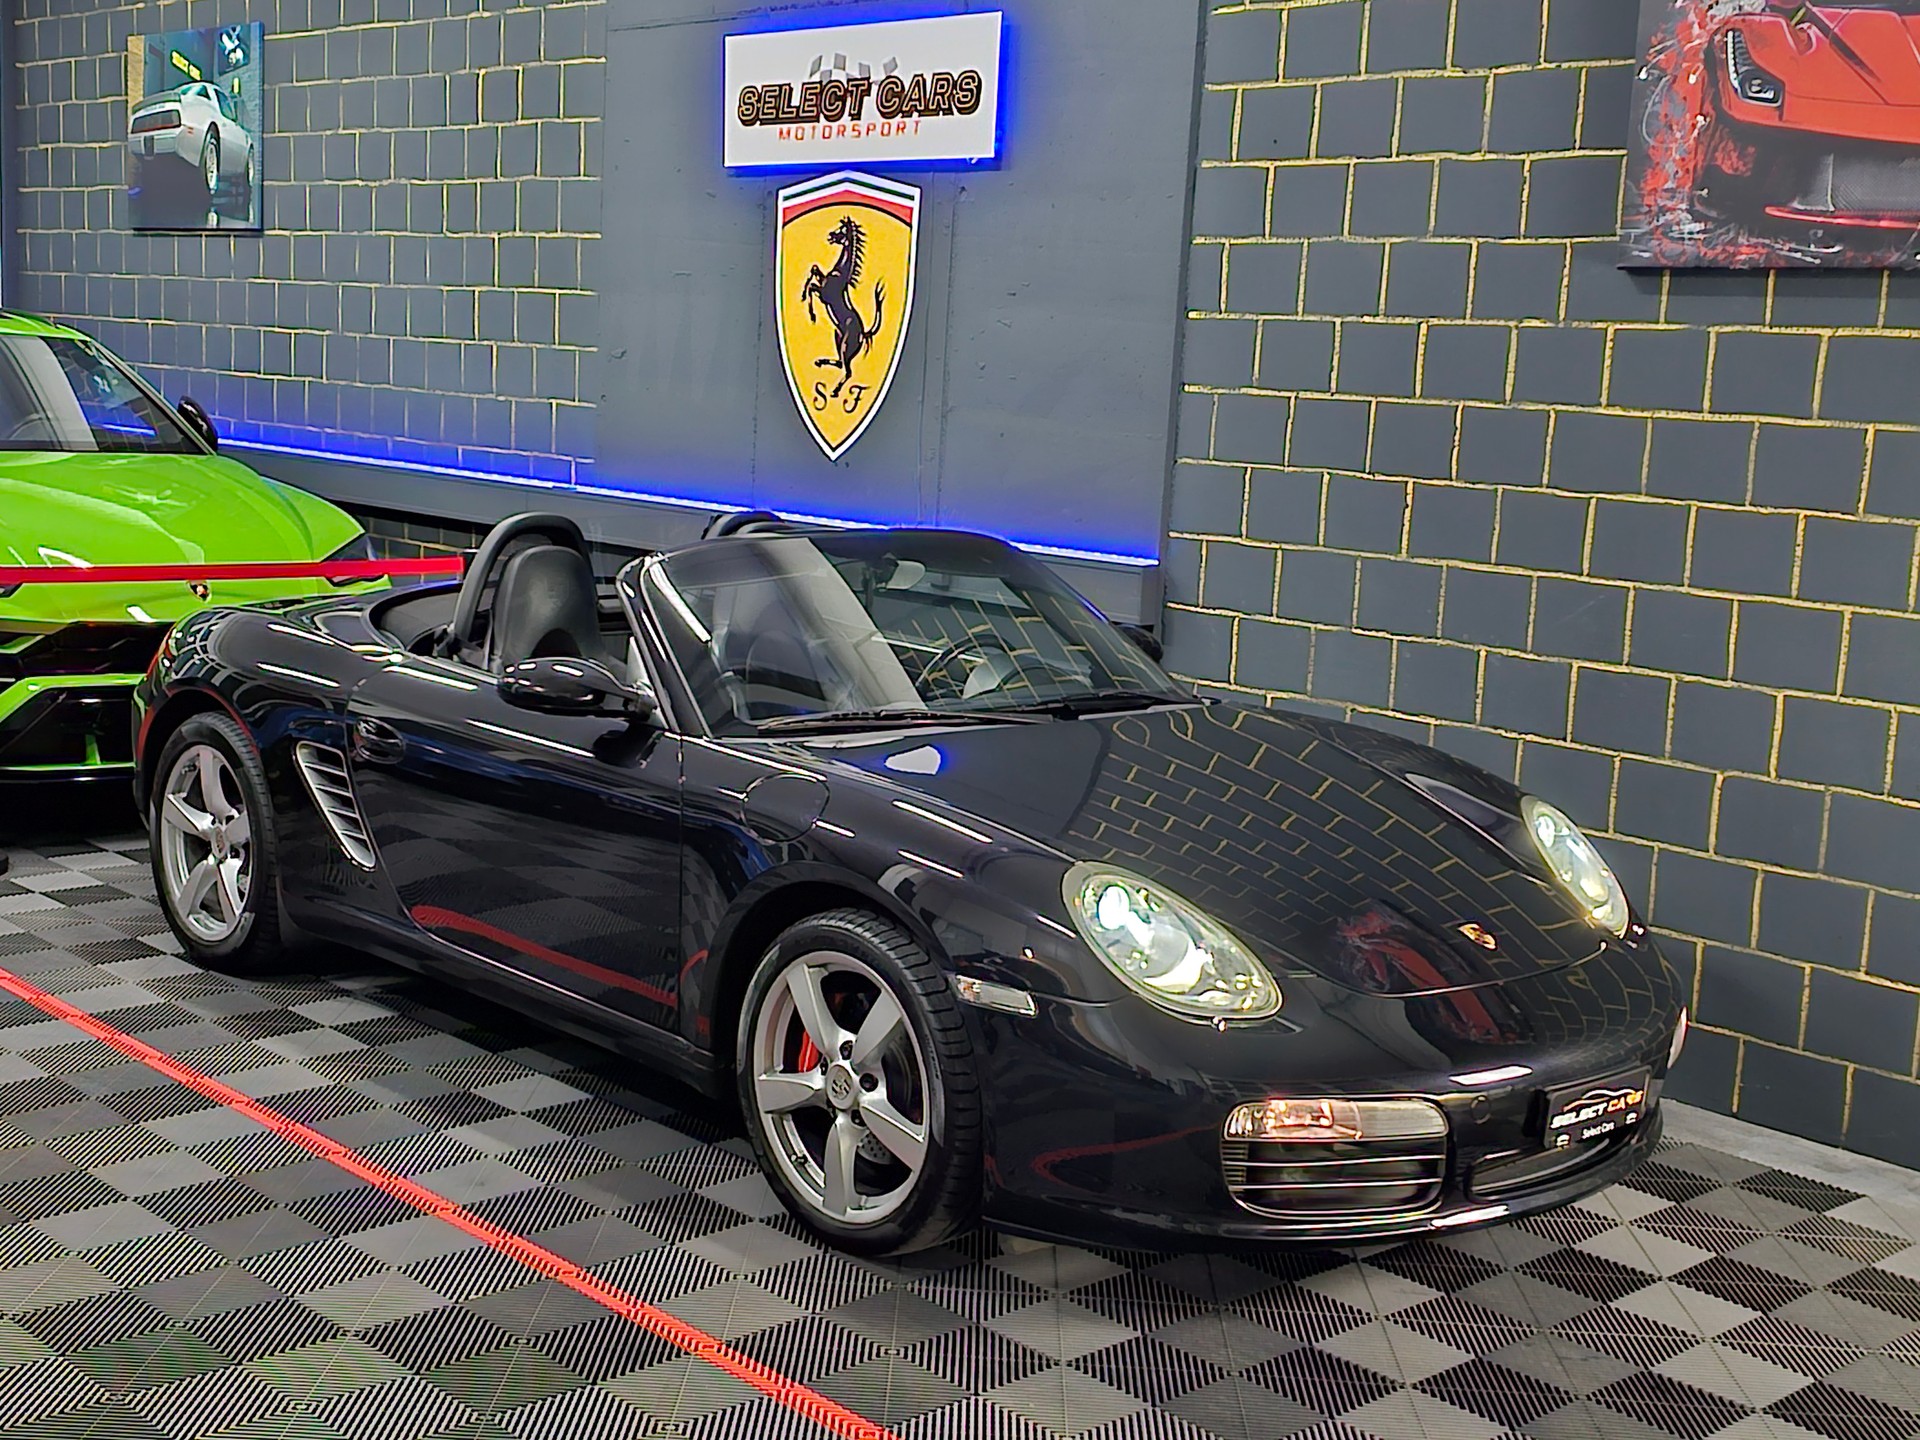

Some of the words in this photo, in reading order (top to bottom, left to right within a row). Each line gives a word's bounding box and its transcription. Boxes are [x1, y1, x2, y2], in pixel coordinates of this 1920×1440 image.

[738, 77, 871, 126] SELECT
[875, 70, 983, 118] CARS
[778, 120, 922, 141] MOTORSPORT
[813, 382, 827, 411] S
[1550, 1102, 1608, 1129] SELECT
